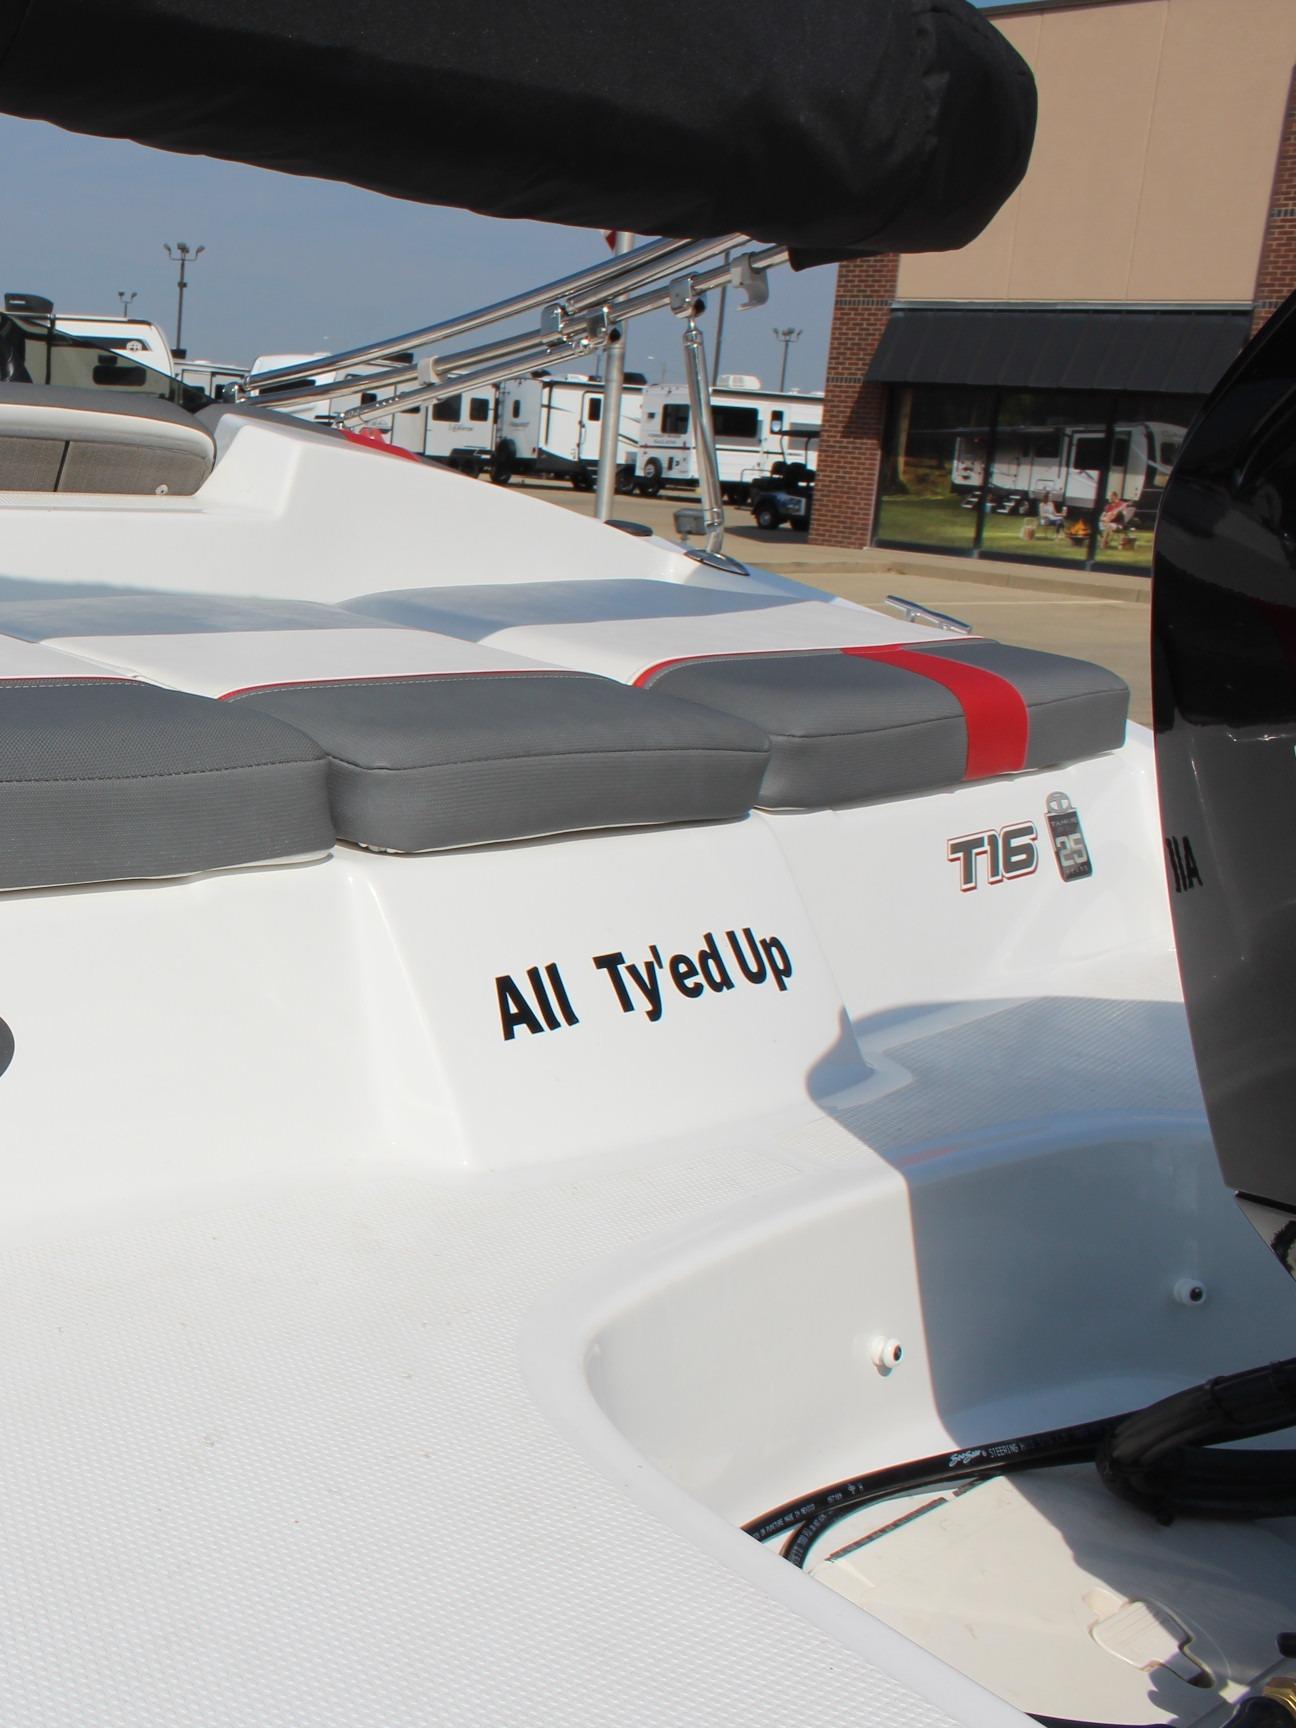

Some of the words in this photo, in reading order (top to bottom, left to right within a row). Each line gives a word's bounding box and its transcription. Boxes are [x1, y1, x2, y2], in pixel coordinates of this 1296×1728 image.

[947, 820, 1039, 892] T16
[1055, 833, 1089, 867] 25
[495, 962, 580, 1041] All
[592, 932, 735, 1022] Ty'ed
[725, 927, 793, 992] Up
